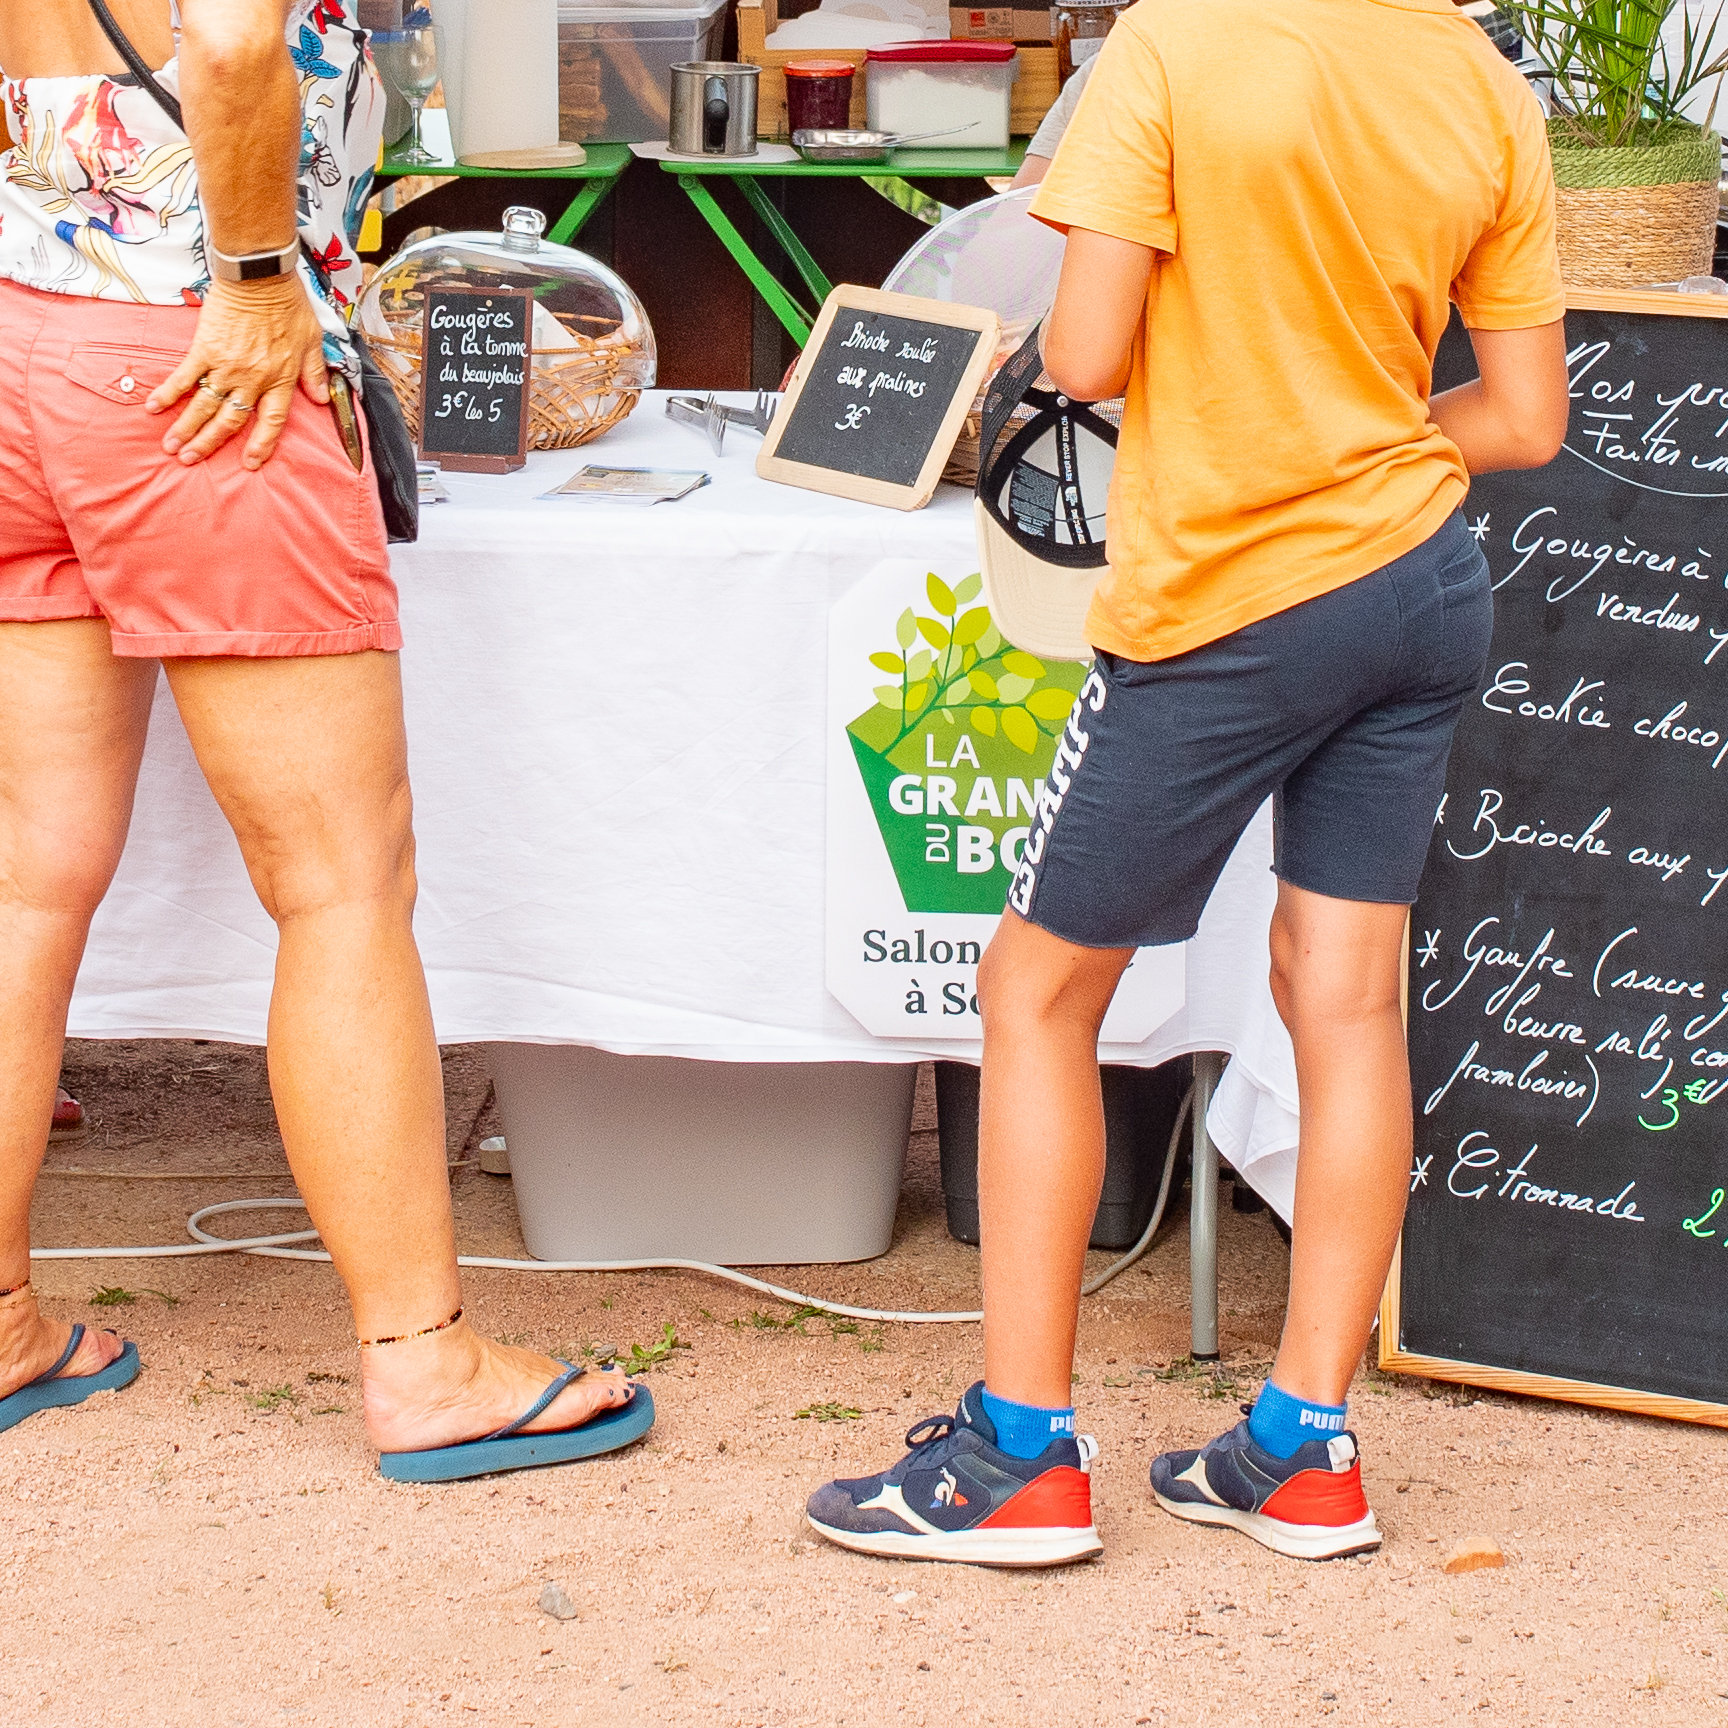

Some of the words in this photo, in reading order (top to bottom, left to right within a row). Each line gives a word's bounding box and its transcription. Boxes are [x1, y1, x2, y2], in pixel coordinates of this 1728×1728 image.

[440, 335, 454, 355] à
[461, 333, 482, 355] la
[485, 334, 528, 357] tomme
[841, 321, 890, 352] Brioche
[895, 338, 939, 363] roulée
[440, 362, 458, 382] du
[462, 362, 525, 390] beaujolais
[837, 366, 867, 389] aux
[868, 371, 926, 398] pralines
[1566, 341, 1634, 402] Nos
[435, 391, 468, 417] 3€
[465, 396, 483, 420] les
[488, 398, 503, 422] 5
[834, 403, 871, 430] 3€
[1062, 443, 1070, 460] STOP
[1492, 507, 1678, 604] Gougères
[1682, 547, 1710, 579] à
[1596, 591, 1698, 632] vendues
[1482, 661, 1611, 730] Cookie
[926, 733, 981, 769] LA
[926, 823, 951, 861] DU
[1446, 788, 1612, 860] Brioche
[1628, 847, 1690, 881] aux
[863, 929, 980, 964] Salon
[1424, 917, 1574, 1016] Gaufre
[1592, 927, 1705, 999] (sucre
[904, 979, 927, 1015] à
[1503, 982, 1586, 1045] beurre
[1638, 1078, 1707, 1130] 3€
[1447, 1131, 1645, 1222] Citronnade
